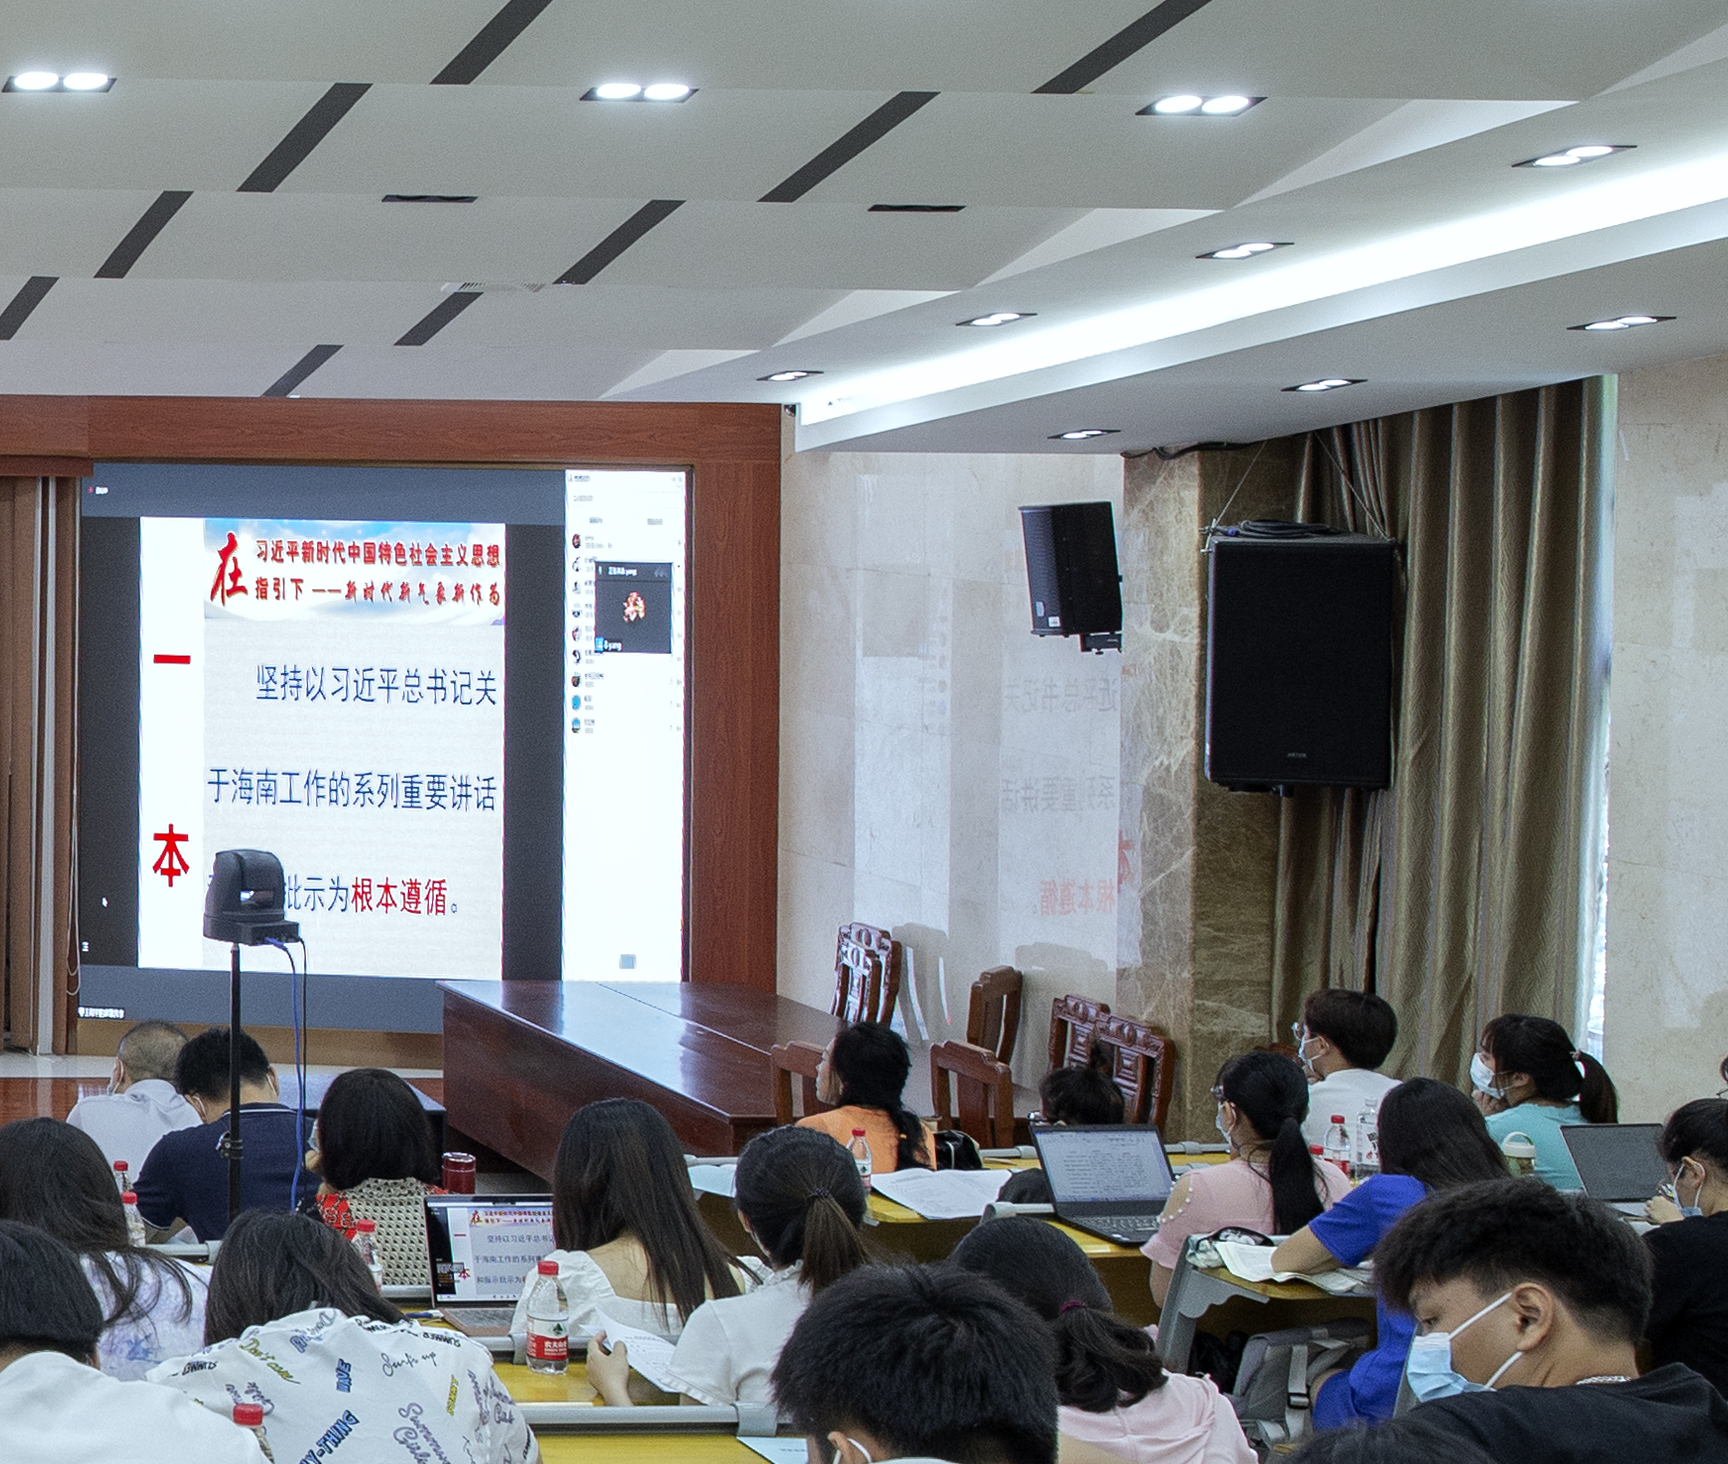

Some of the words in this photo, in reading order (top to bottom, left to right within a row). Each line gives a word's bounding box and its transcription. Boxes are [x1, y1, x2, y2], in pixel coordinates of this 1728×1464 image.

[211, 531, 249, 607] 在
[255, 538, 501, 569] 习近平新时代中国特色社会主义思想
[255, 664, 498, 707] 坚持以习近平总书记关
[207, 767, 498, 812] 于海南工作的系列重要讲话
[152, 823, 191, 888] 本
[422, 1351, 438, 1367] up
